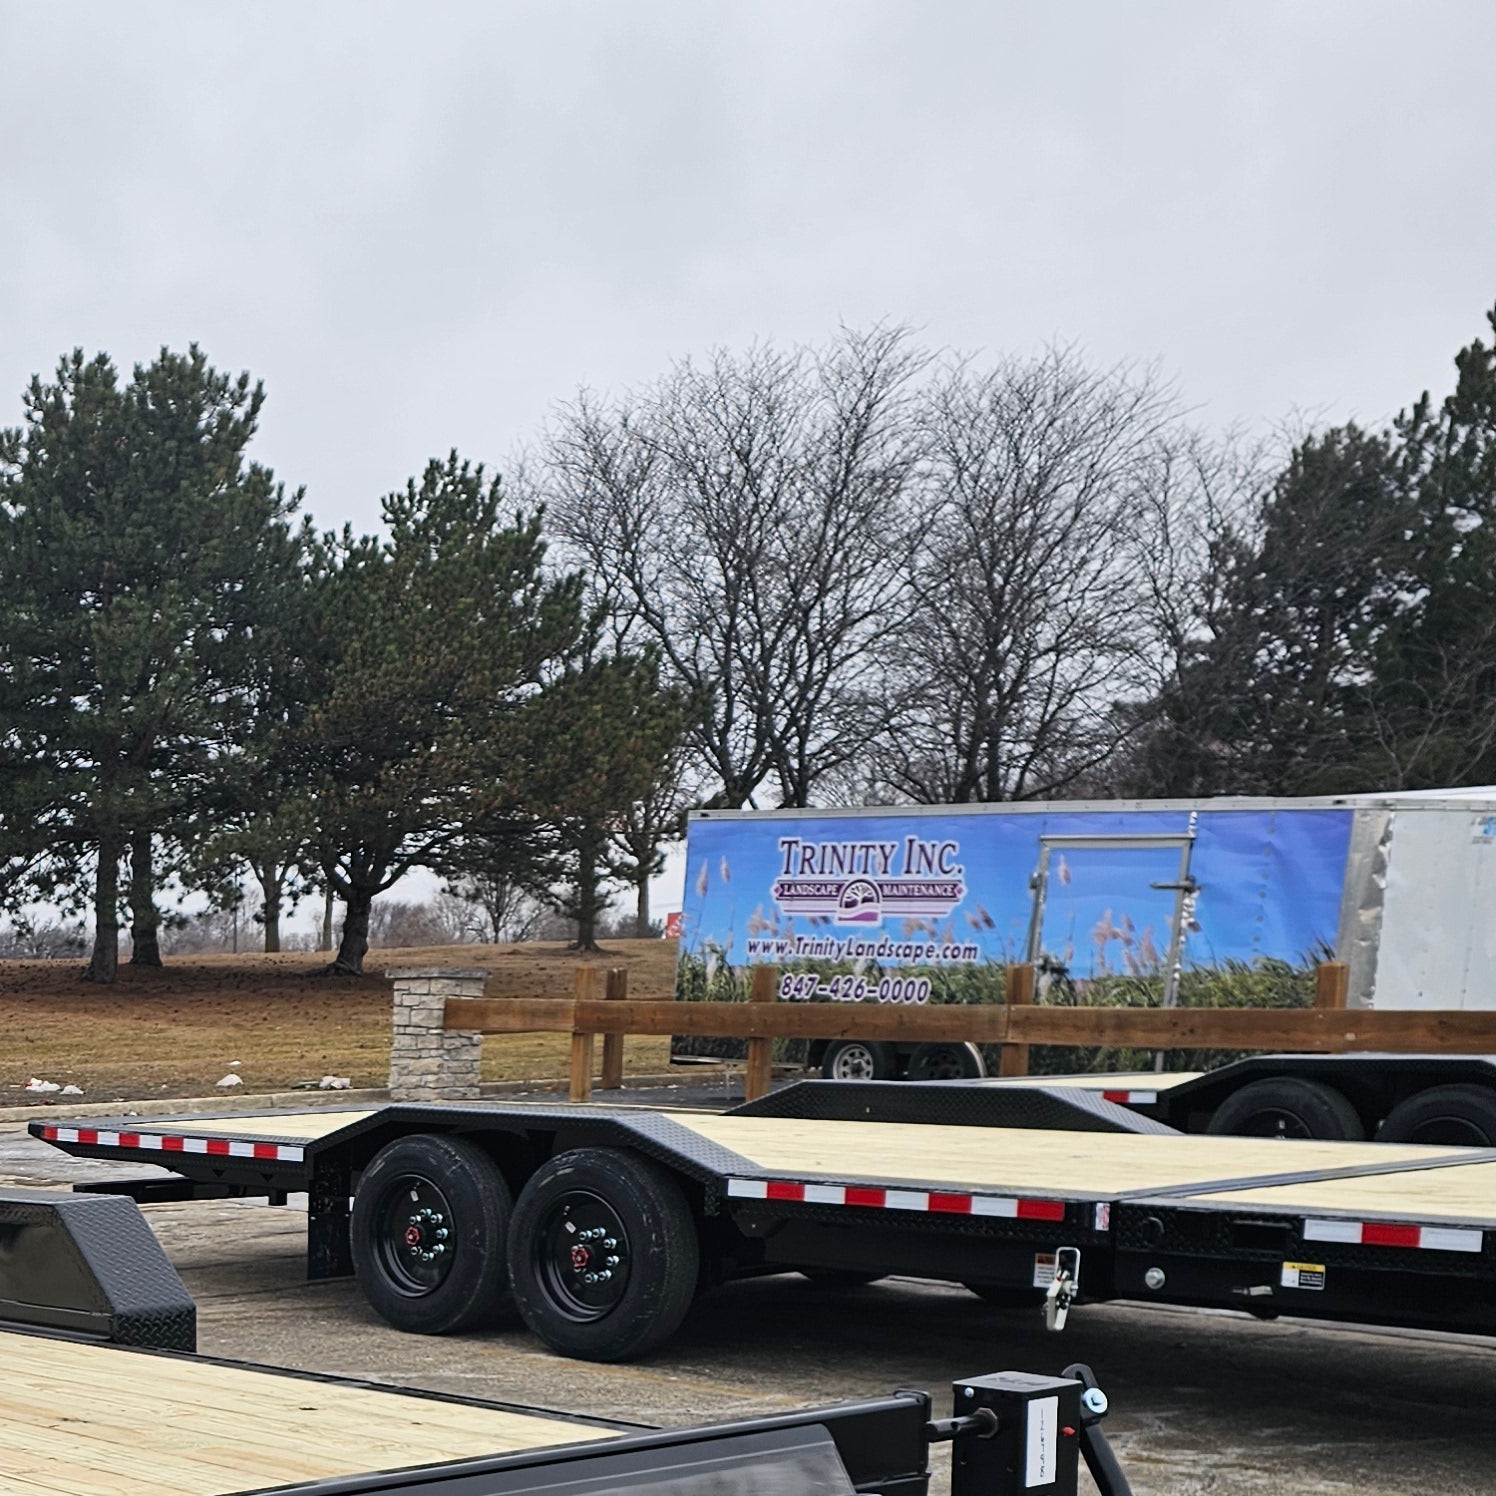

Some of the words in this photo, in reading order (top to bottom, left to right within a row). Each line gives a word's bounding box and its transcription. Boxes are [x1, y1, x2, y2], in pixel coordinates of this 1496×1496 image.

[779, 838, 898, 876] TRINITY
[904, 836, 964, 876] INC.
[783, 883, 839, 897] LANDSCAPE
[882, 883, 955, 897] MAINTENANCE
[747, 936, 979, 962] www.TrinityLandscape.com
[780, 974, 931, 1003] 847-426-0000
